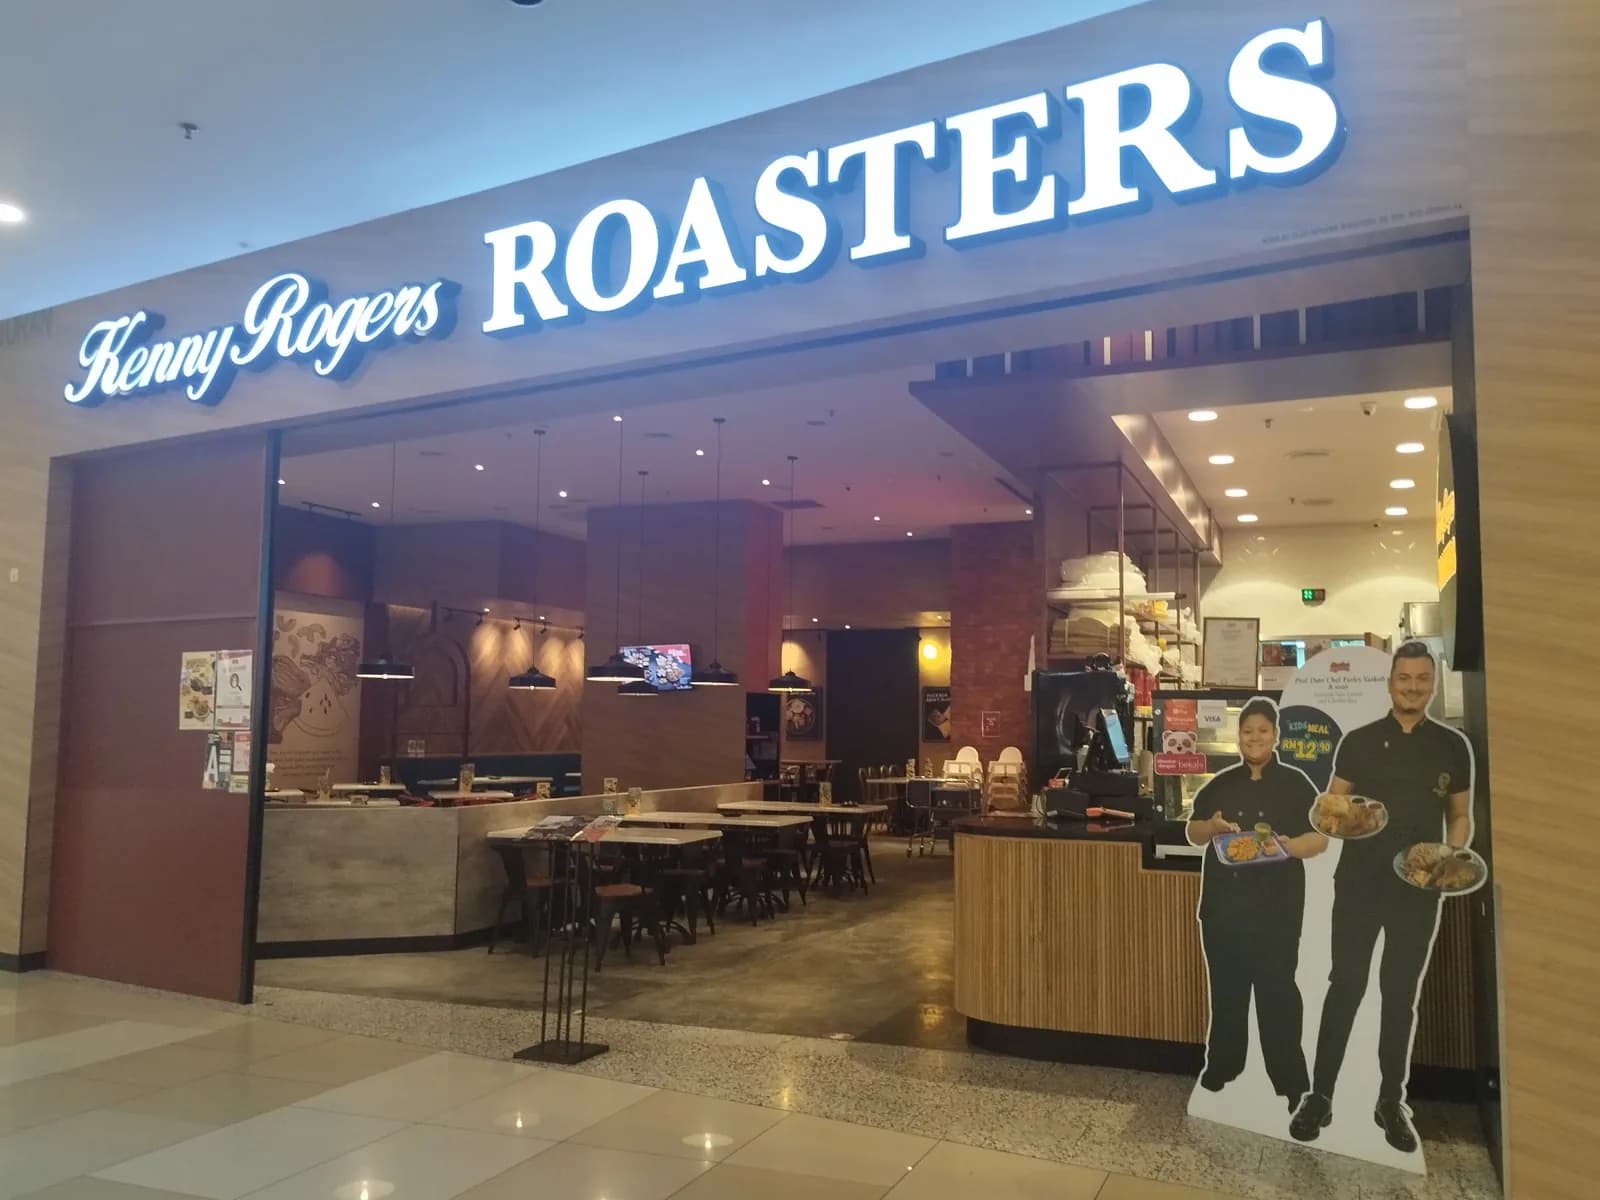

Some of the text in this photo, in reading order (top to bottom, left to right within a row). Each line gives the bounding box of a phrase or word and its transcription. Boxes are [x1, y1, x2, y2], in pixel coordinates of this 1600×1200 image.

[64, 19, 1339, 404] Kenny Rogers ROASTERS
